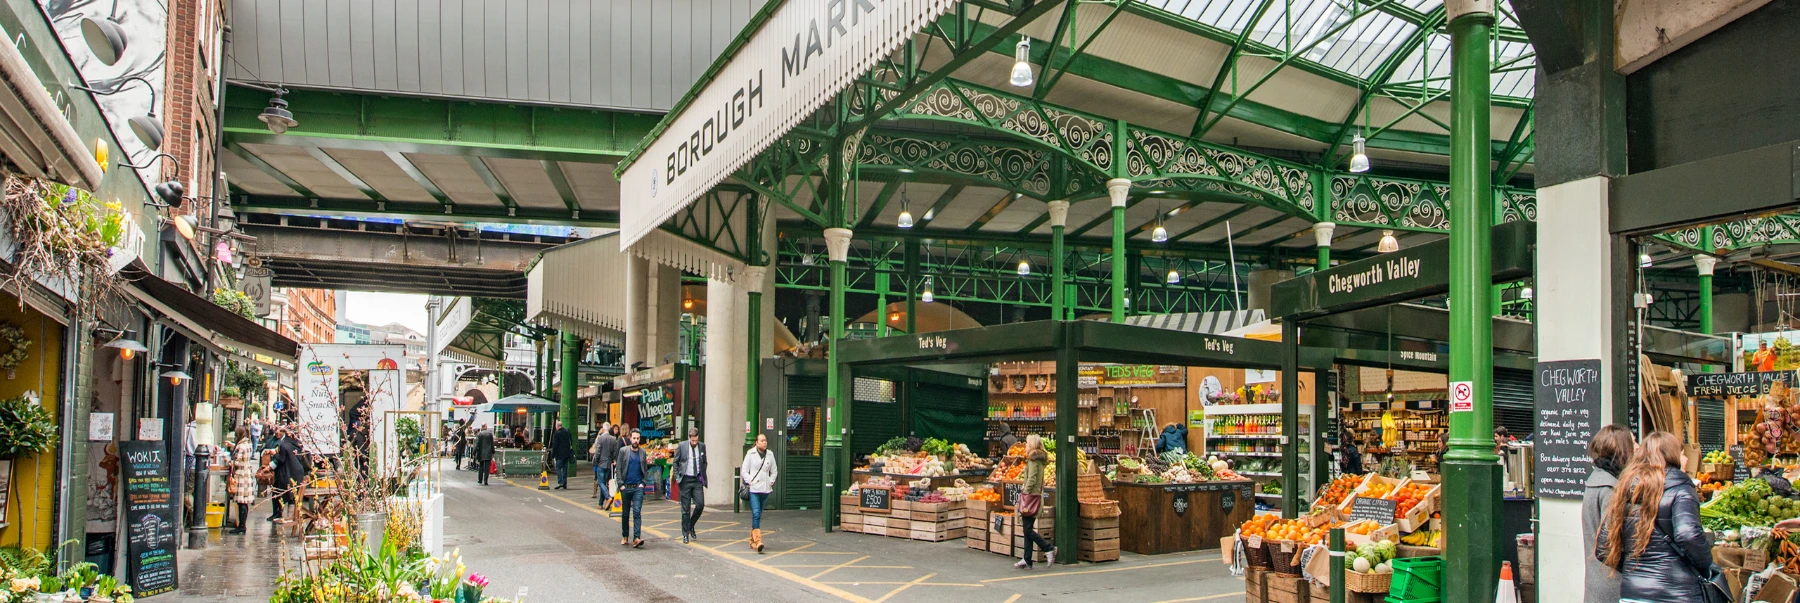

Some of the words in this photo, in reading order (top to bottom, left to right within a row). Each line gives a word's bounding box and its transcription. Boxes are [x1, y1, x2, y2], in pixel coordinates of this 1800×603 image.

[667, 69, 763, 186] BOROUGH
[1329, 263, 1383, 294] Chegworth
[1386, 256, 1420, 280] Valley
[919, 336, 933, 349] Ted's
[935, 335, 947, 349] Veg
[1204, 337, 1220, 352] Ted's
[1222, 339, 1234, 355] Veg
[1133, 365, 1153, 378] VEG
[1542, 367, 1598, 387] CHEGWORTH
[1696, 373, 1754, 386] CHEGWORTH
[641, 385, 663, 404] Paul
[1554, 387, 1587, 404] VALLEY
[1694, 385, 1722, 396] FRESH
[1727, 384, 1758, 395] JUICE
[308, 400, 334, 409] Snacks
[638, 401, 674, 419] Wheeler
[316, 412, 324, 420] &
[1580, 409, 1589, 418] veg
[1562, 419, 1575, 431] daily
[1555, 437, 1570, 445] miles
[127, 450, 162, 463] WOKIT
[1540, 452, 1551, 462] Box
